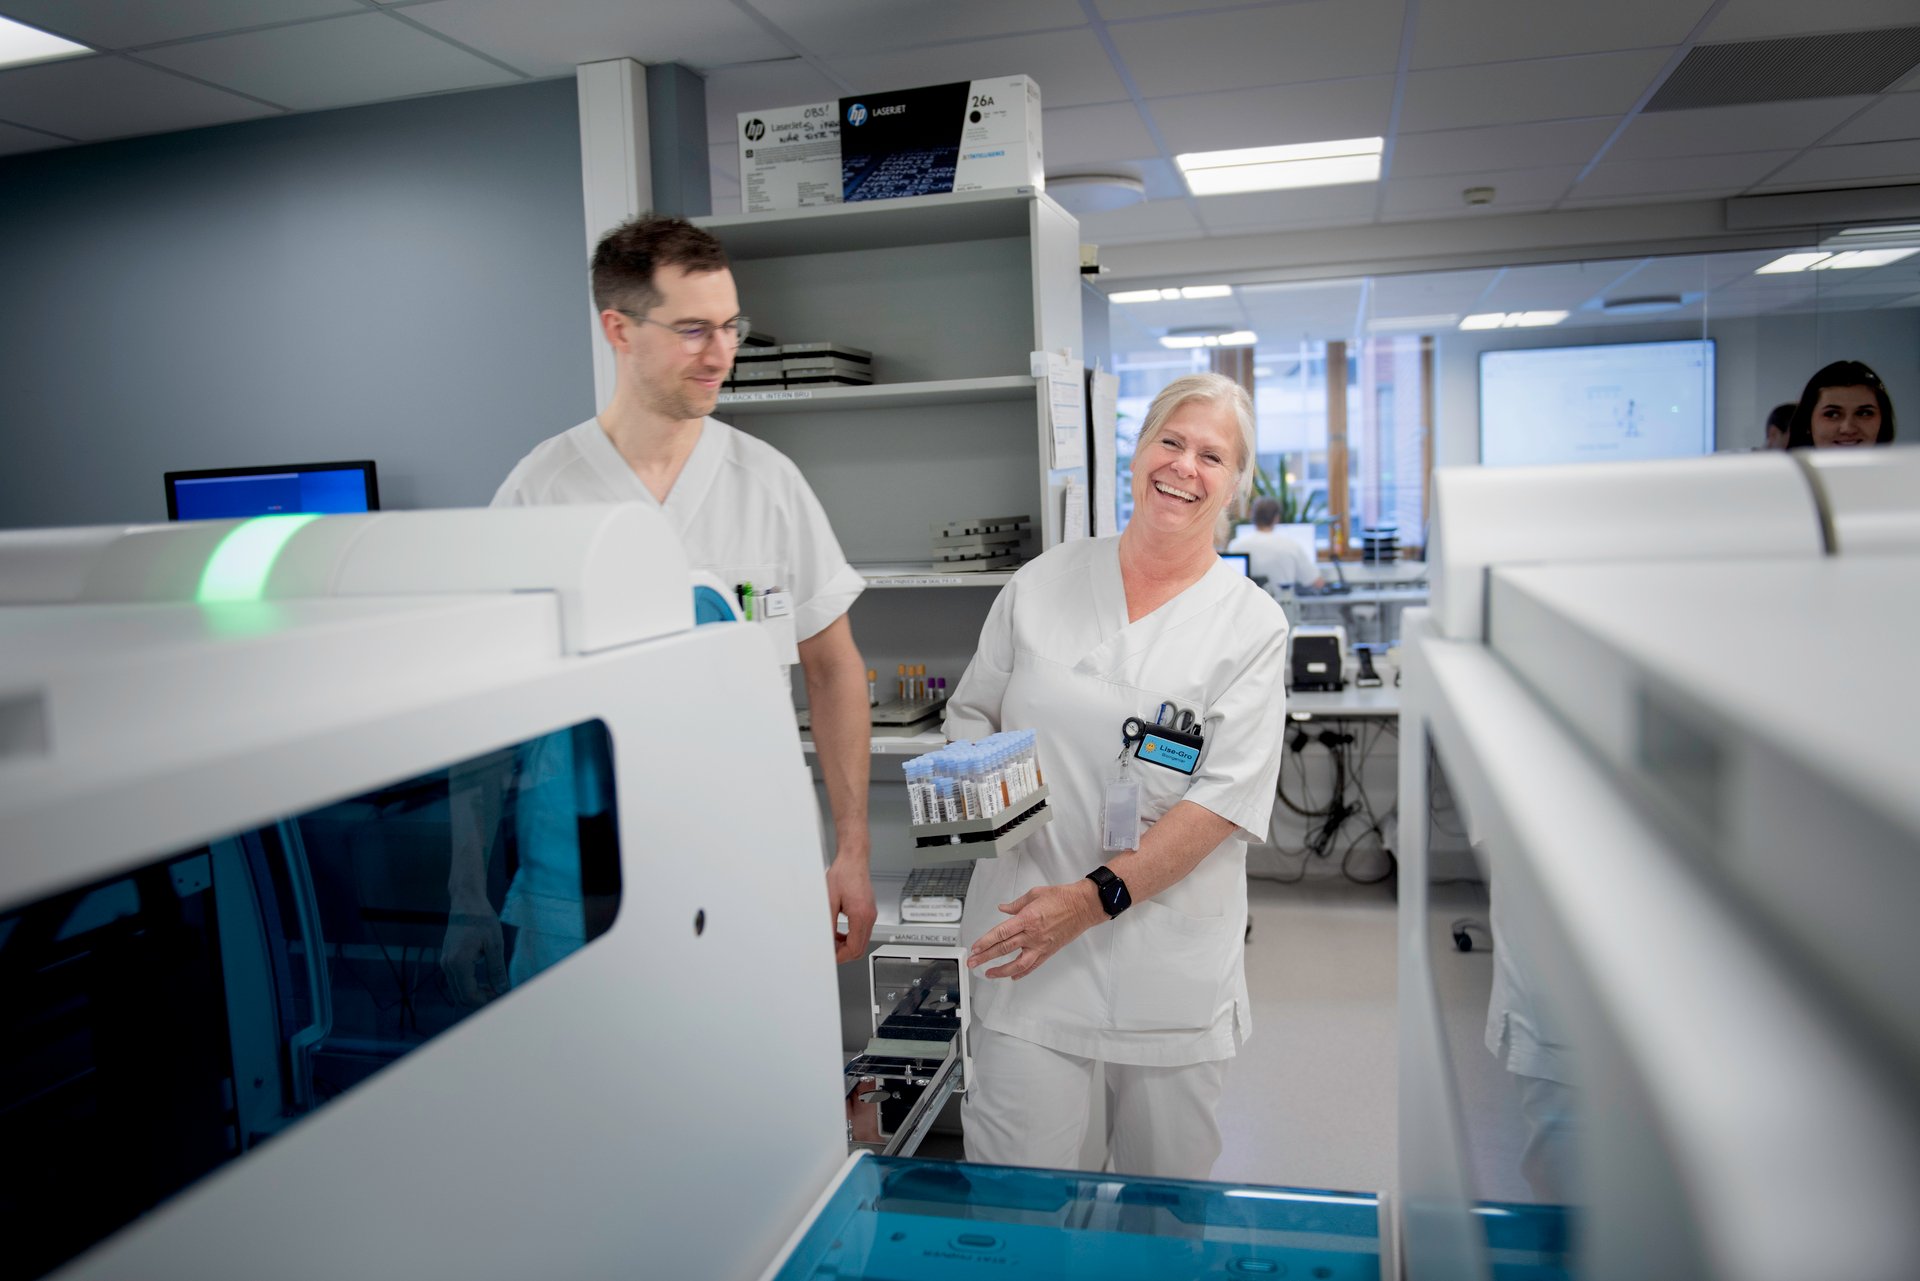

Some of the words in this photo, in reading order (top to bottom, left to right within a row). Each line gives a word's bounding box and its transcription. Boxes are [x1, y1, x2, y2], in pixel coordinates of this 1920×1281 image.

[972, 95, 995, 108] 26A
[804, 104, 829, 118] OBS!
[849, 104, 867, 126] hp
[872, 104, 906, 117] LASERJET
[747, 119, 765, 141] hp
[771, 122, 803, 132] LaserJet
[866, 174, 903, 182] NEW
[872, 168, 919, 176] HONG
[861, 178, 934, 188] MADRID
[732, 393, 753, 401] RACK
[765, 391, 793, 399] INTERN
[794, 390, 810, 398] BRU
[1160, 745, 1192, 759] Lise-Gro
